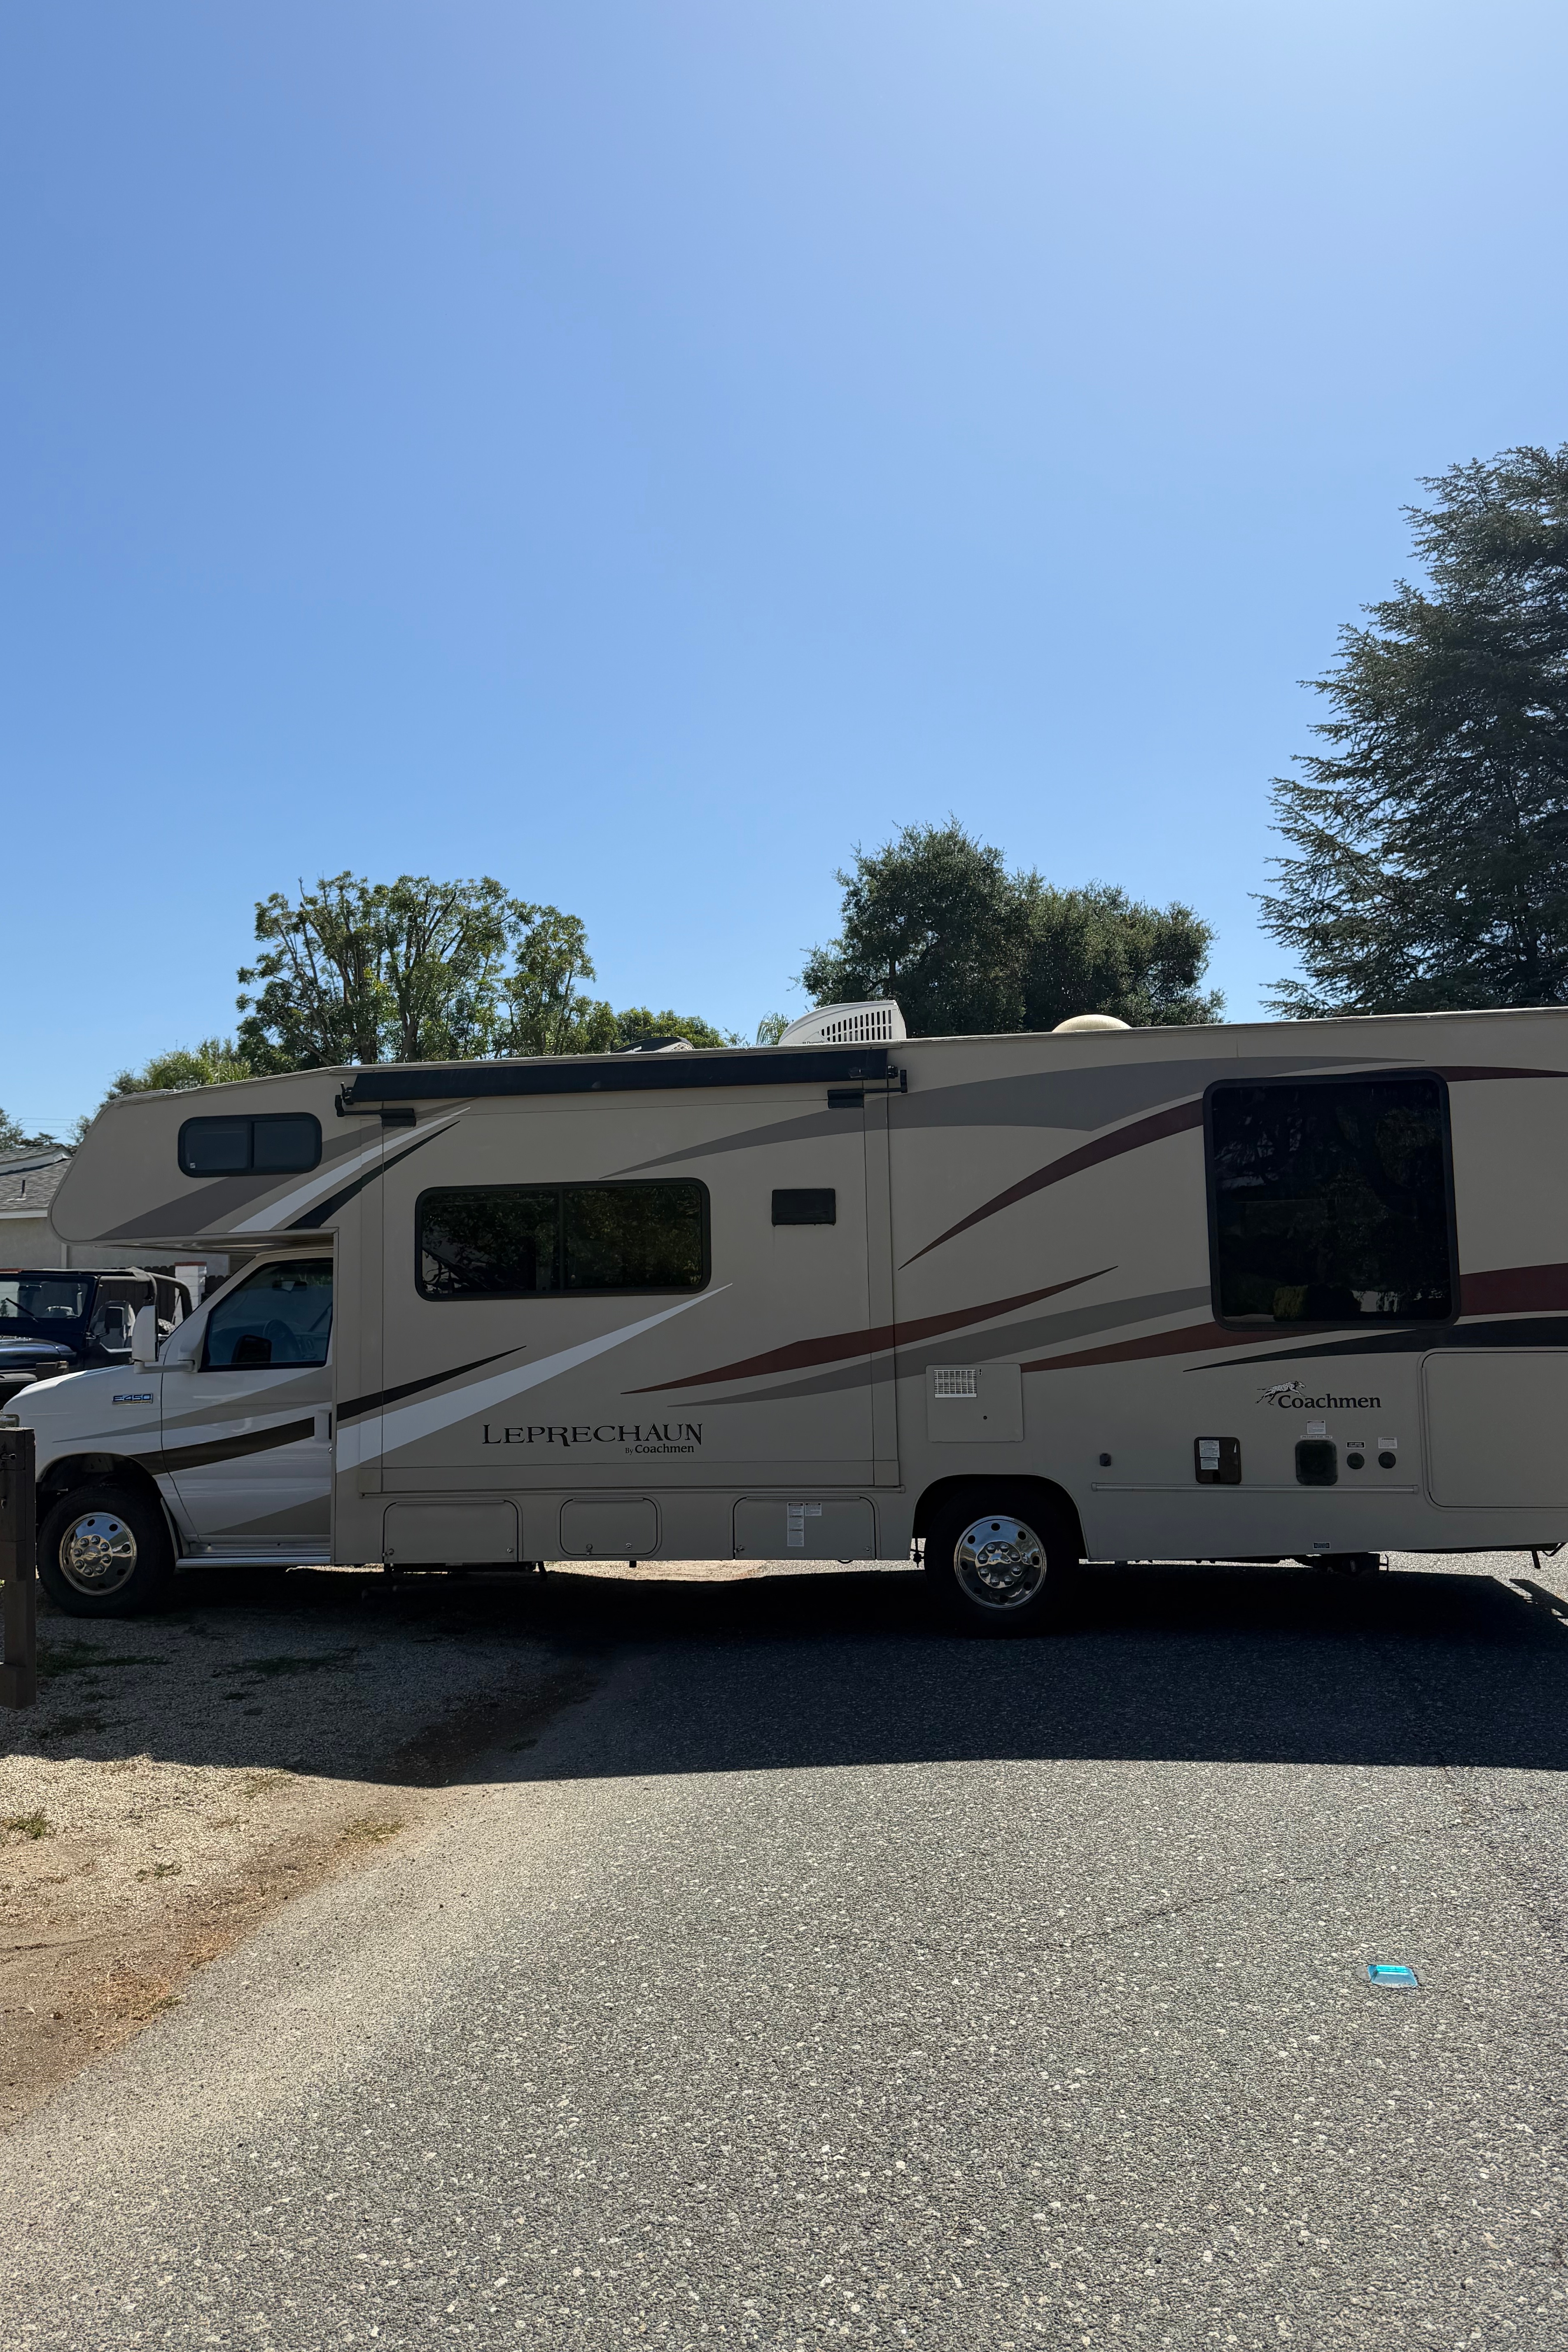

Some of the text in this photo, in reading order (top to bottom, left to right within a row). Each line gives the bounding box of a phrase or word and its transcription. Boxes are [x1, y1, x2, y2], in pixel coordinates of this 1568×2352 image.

[1278, 1393, 1381, 1409] Coachmen
[482, 1423, 703, 1447] LEPRECHAUN
[635, 1444, 694, 1454] Coachmen
